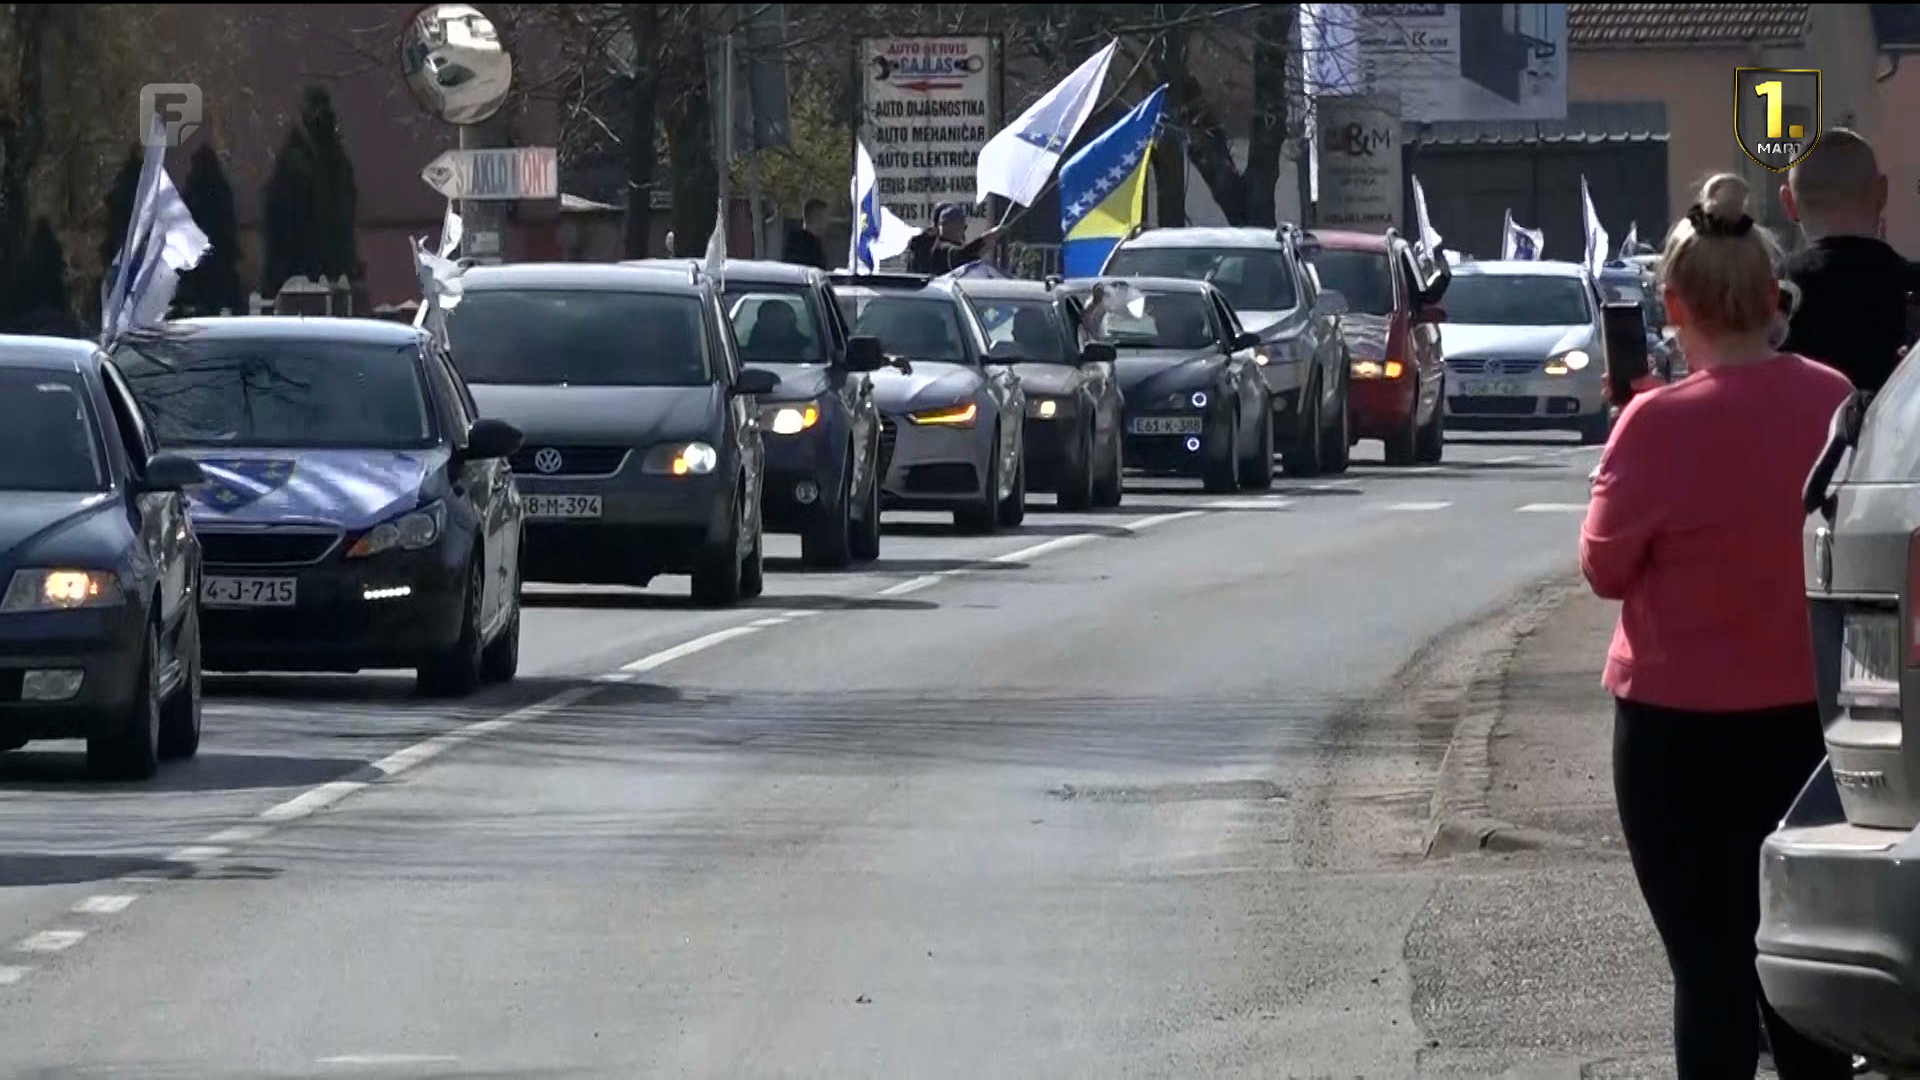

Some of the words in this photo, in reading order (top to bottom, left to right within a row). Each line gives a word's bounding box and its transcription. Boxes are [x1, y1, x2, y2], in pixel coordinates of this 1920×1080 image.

[886, 43, 920, 55] AUTO
[924, 42, 968, 55] SERVIS
[906, 100, 985, 117] DIJAGNOSTIKA
[912, 123, 985, 142] MEHANIČAR
[912, 148, 978, 168] ELEKTRIČA
[202, 580, 293, 602] 4-J-715
